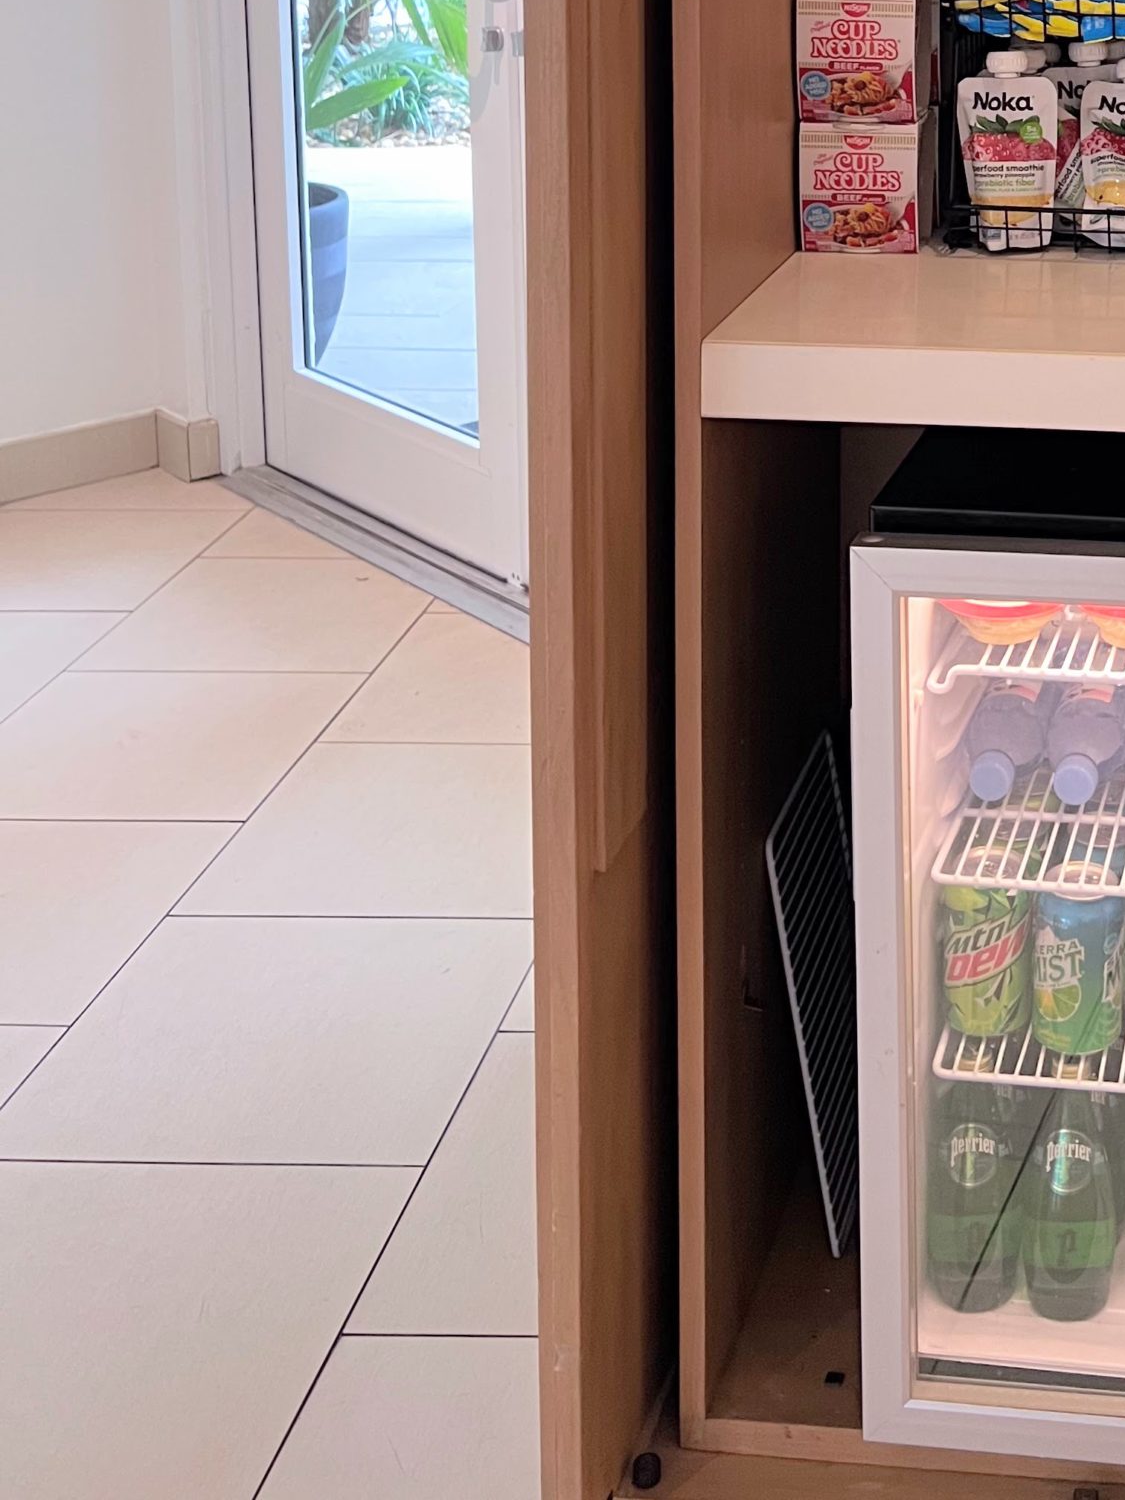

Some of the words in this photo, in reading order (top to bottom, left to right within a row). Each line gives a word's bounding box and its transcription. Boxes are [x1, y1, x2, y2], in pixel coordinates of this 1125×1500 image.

[831, 19, 881, 39] CUP
[810, 37, 898, 60] NOODLES
[833, 62, 859, 70] BEEF
[972, 92, 1033, 111] Noka
[833, 152, 884, 172] CUP
[1006, 163, 1045, 172] smoothie
[813, 170, 901, 191] NOODLES
[836, 194, 862, 202] BEEF
[1039, 941, 1078, 955] ERRA
